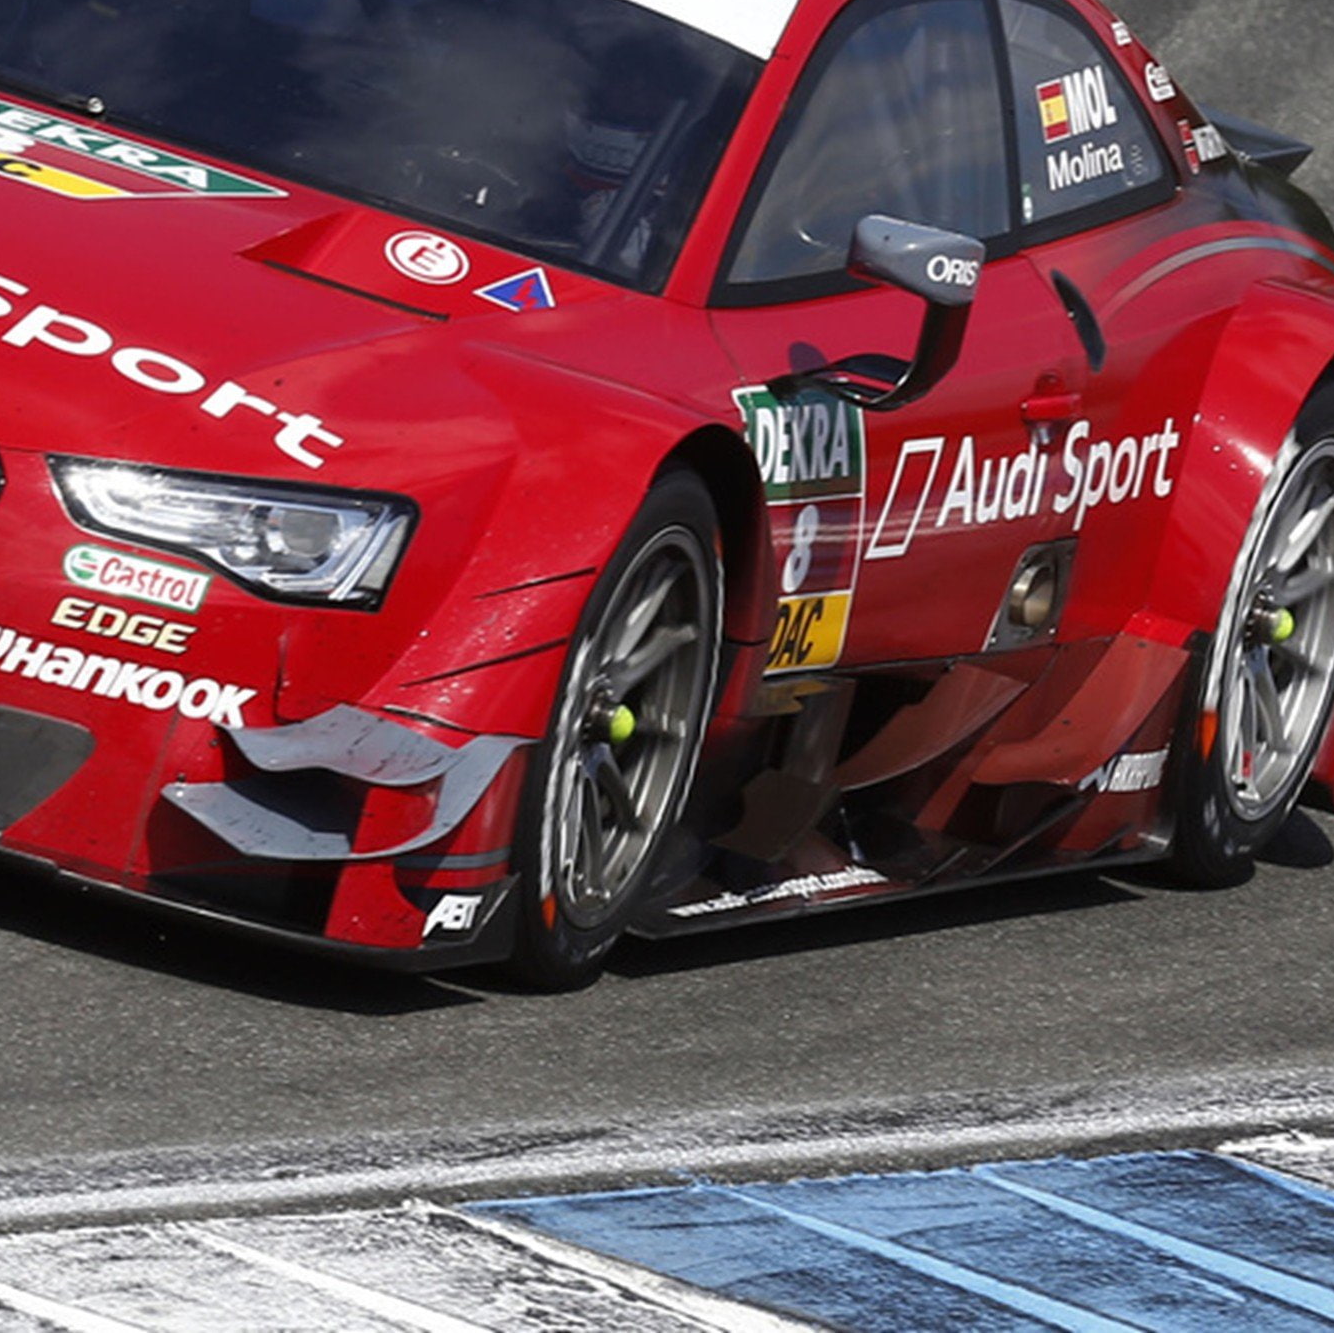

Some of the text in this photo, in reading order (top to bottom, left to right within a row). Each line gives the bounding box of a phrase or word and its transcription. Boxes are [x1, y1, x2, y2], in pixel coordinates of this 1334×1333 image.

[1063, 66, 1118, 136] MOL
[1046, 141, 1125, 192] Molina
[756, 400, 851, 485] DEKRA
[934, 417, 1180, 533] Audi Sport
[97, 554, 202, 611] Castrol
[781, 504, 821, 595] 8
[50, 597, 199, 655] EDGE
[766, 598, 824, 668] DAC
